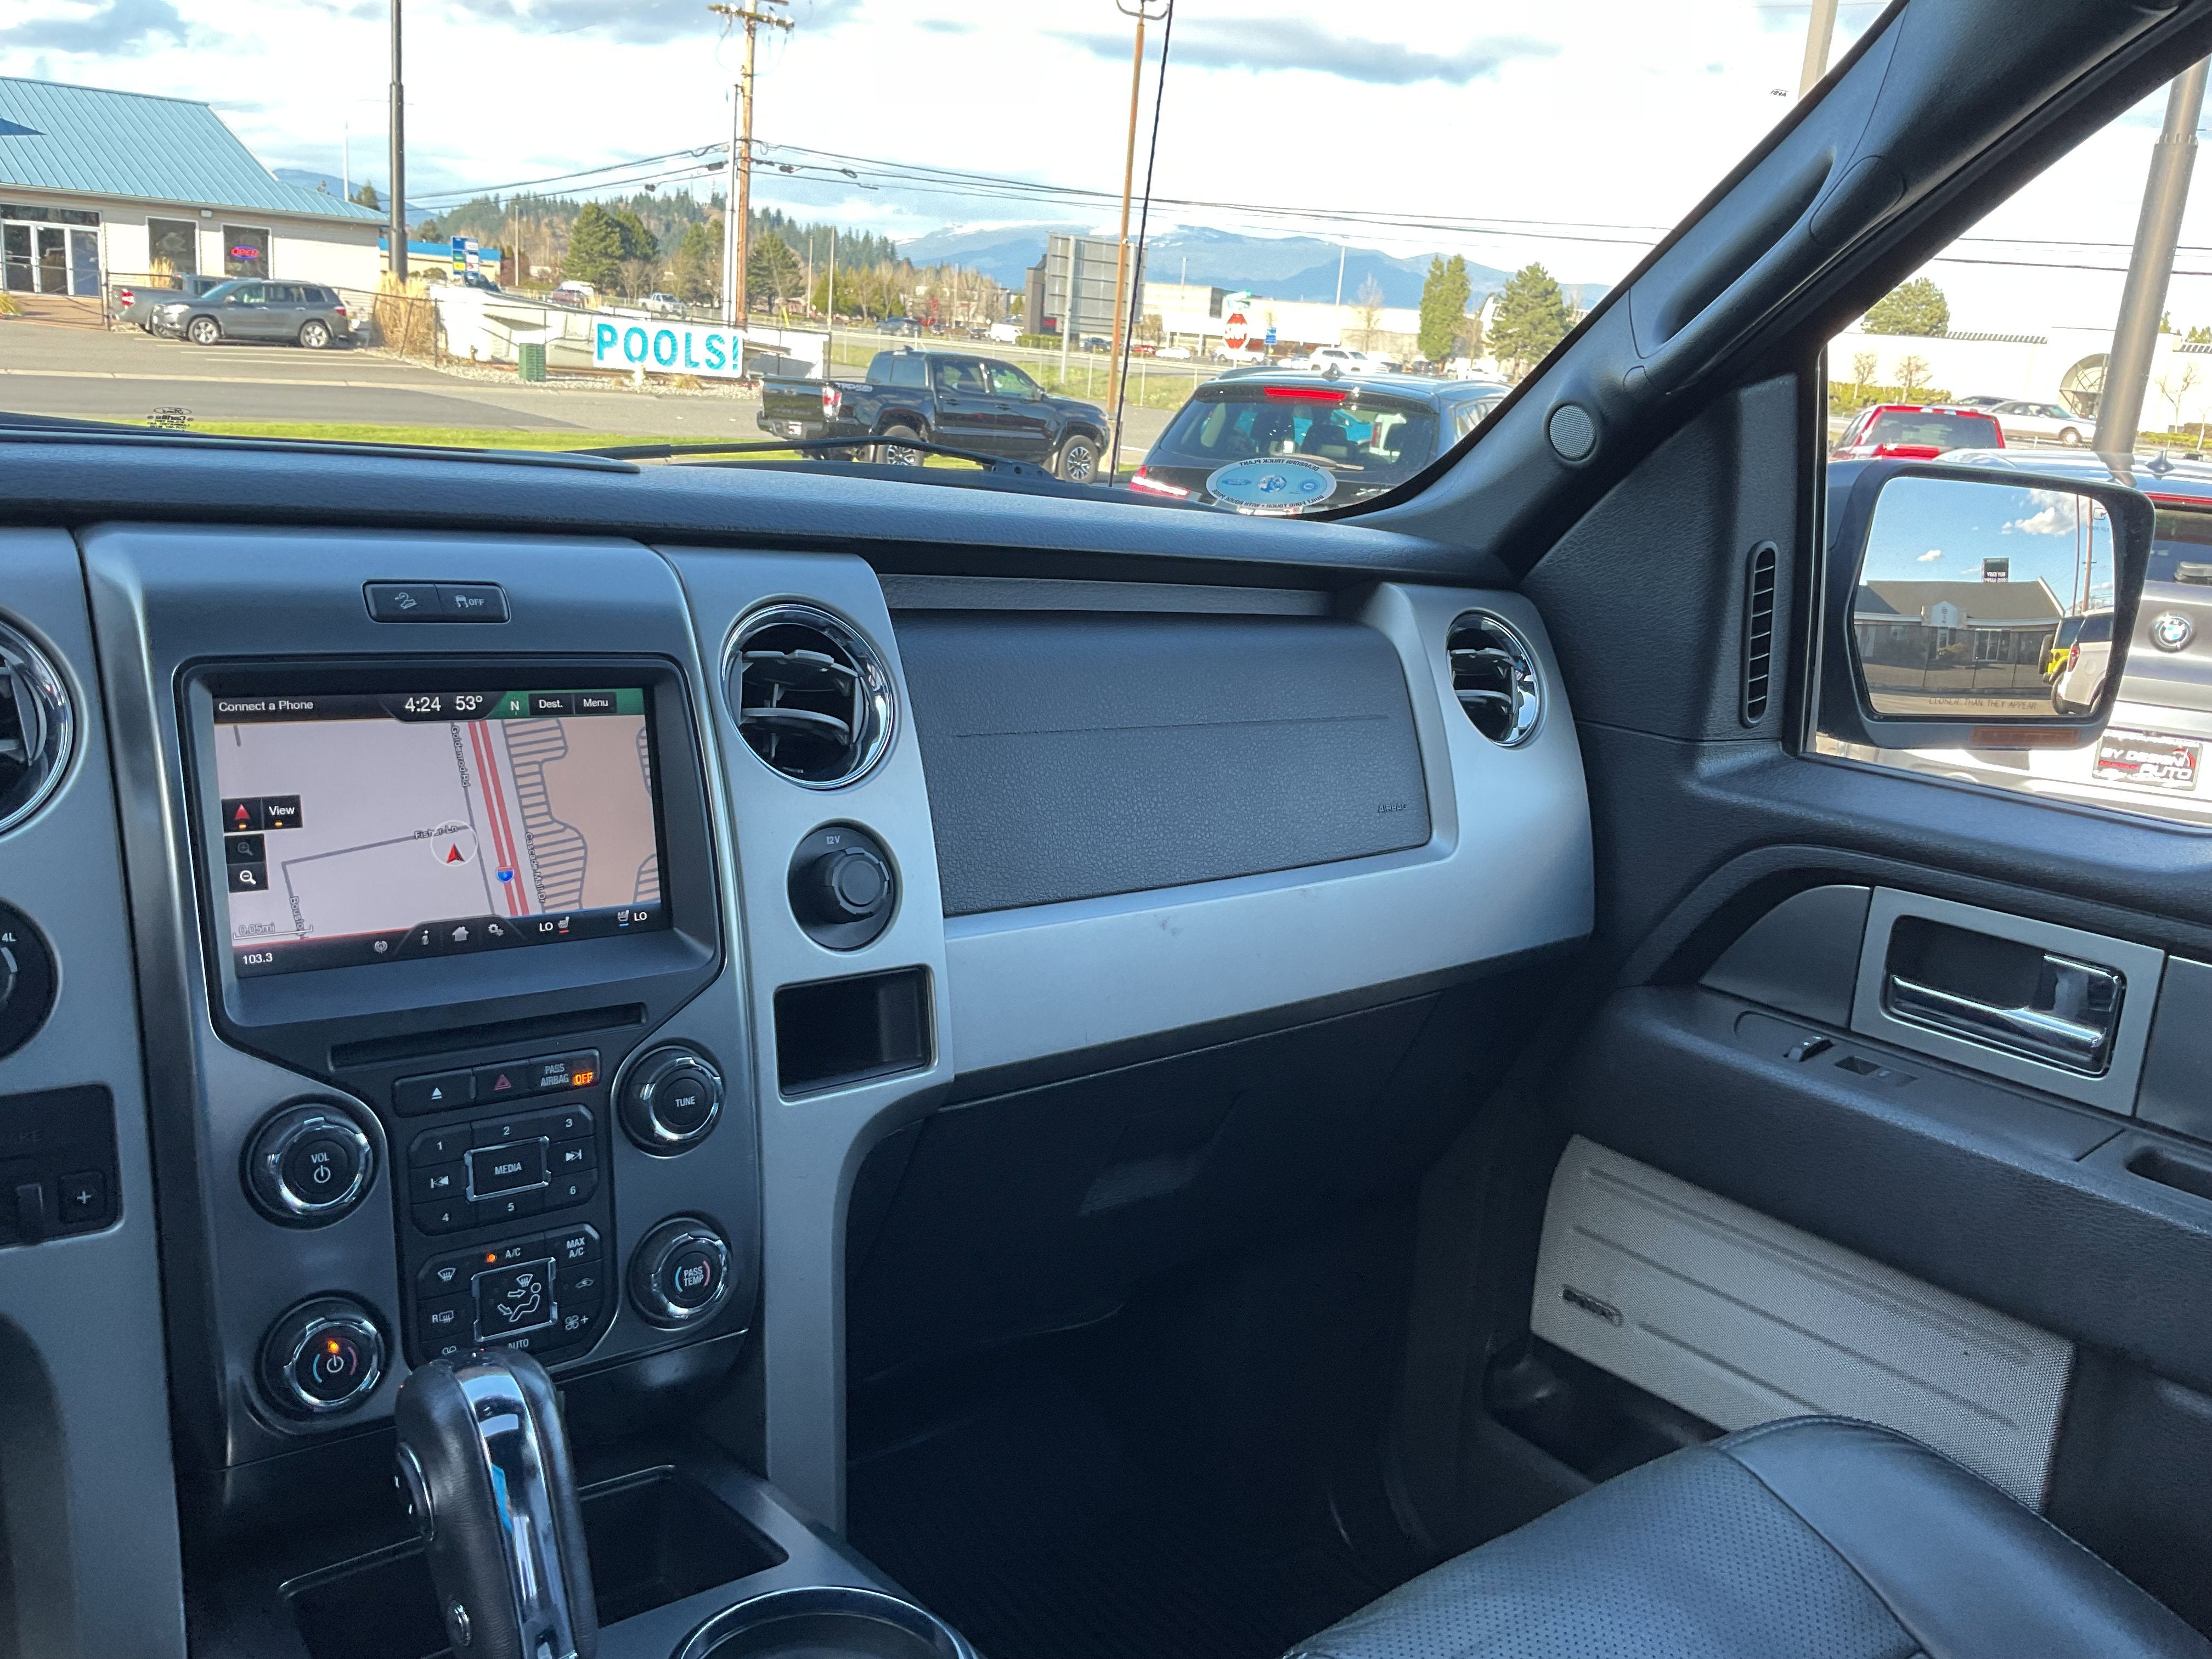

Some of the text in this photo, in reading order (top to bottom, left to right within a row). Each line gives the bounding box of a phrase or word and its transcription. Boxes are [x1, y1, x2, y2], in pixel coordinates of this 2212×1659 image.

[231, 247, 259, 257] OPEN
[597, 323, 738, 370] POOLS!
[219, 702, 266, 712] Connect
[279, 700, 314, 709] Phone
[405, 697, 442, 712] 4:24
[455, 695, 483, 711] 53°
[510, 701, 520, 710] N
[539, 699, 563, 708] Dest.
[583, 698, 608, 708] Menu
[451, 725, 471, 787] Goldenrod Rd
[269, 806, 295, 816] View
[1378, 803, 1408, 813] AIRBAG
[414, 827, 443, 839] Fisher
[826, 836, 840, 845] 12V
[525, 832, 546, 904] Cascade Mall Dr
[634, 911, 647, 921] LO
[238, 922, 275, 935] 0.05mi
[539, 922, 554, 932] LO
[2, 932, 16, 942] 4L
[241, 952, 273, 964] 103.3
[544, 1063, 566, 1075] PASS
[540, 1073, 569, 1087] AIRBAG
[574, 1071, 594, 1086] OFF
[675, 1096, 696, 1107] TUNE
[565, 1118, 573, 1128] 3
[503, 1126, 511, 1136] 2
[437, 1141, 443, 1151] 1
[311, 1152, 330, 1164] VOL
[494, 1162, 522, 1175] MEDIA
[569, 1186, 577, 1195] 6
[507, 1202, 515, 1212] 5
[441, 1212, 450, 1222] 4
[567, 1237, 585, 1249] MAX
[505, 1247, 522, 1259] A/C
[569, 1246, 584, 1258] A/C
[684, 1266, 703, 1278] PASS
[684, 1274, 704, 1286] TEMP
[507, 1339, 529, 1349] AUTO
